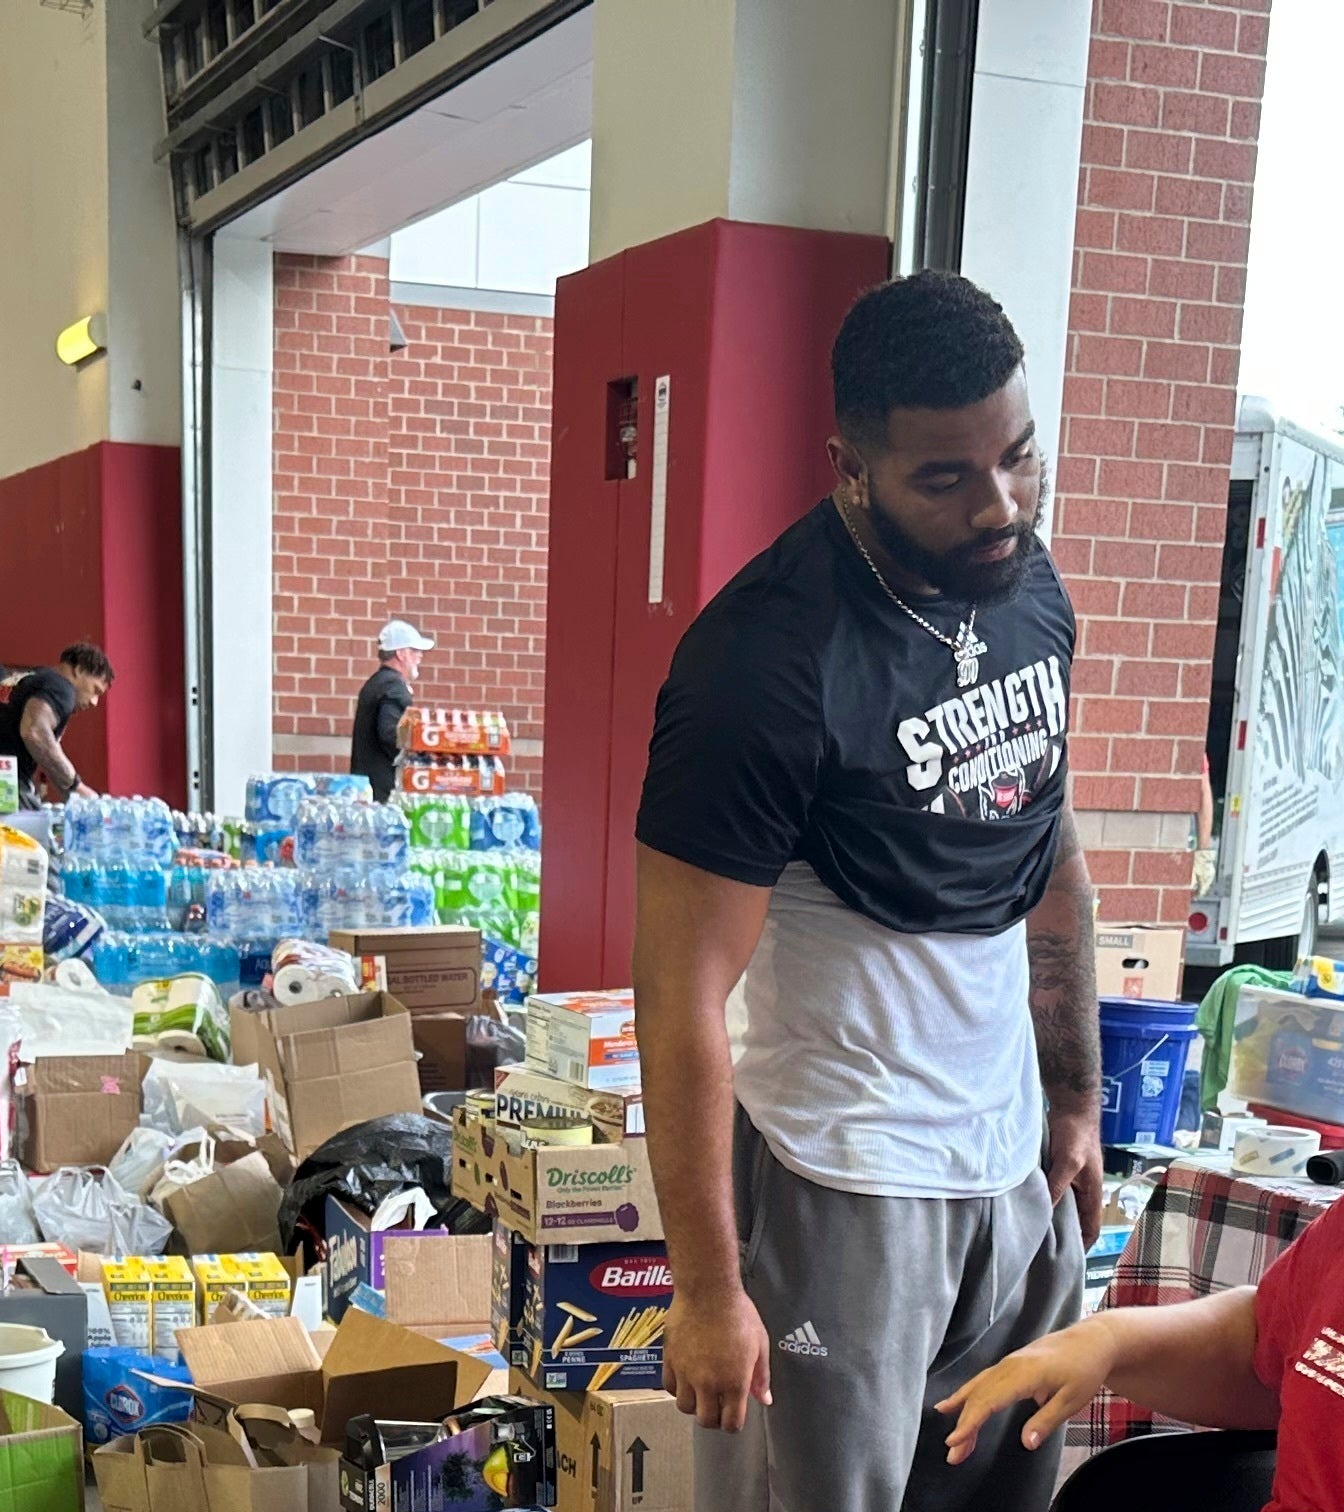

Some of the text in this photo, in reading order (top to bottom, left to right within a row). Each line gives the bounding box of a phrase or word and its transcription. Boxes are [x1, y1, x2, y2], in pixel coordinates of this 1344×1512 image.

[897, 655, 1066, 791] STRENGTH
[422, 726, 439, 747] G
[948, 728, 1049, 794] CONDITIONING
[412, 770, 430, 790] G
[1098, 936, 1131, 947] SMALL
[545, 1164, 634, 1188] Driscoll's
[546, 1199, 603, 1209] Blackberries
[602, 1266, 673, 1287] Barilla
[113, 1291, 147, 1302] Cheerios
[158, 1291, 190, 1302] Cheerios
[253, 1289, 285, 1300] Cheerios
[778, 1337, 828, 1357] adidas
[562, 1354, 586, 1364] PENNE
[376, 1481, 387, 1507] 2000
